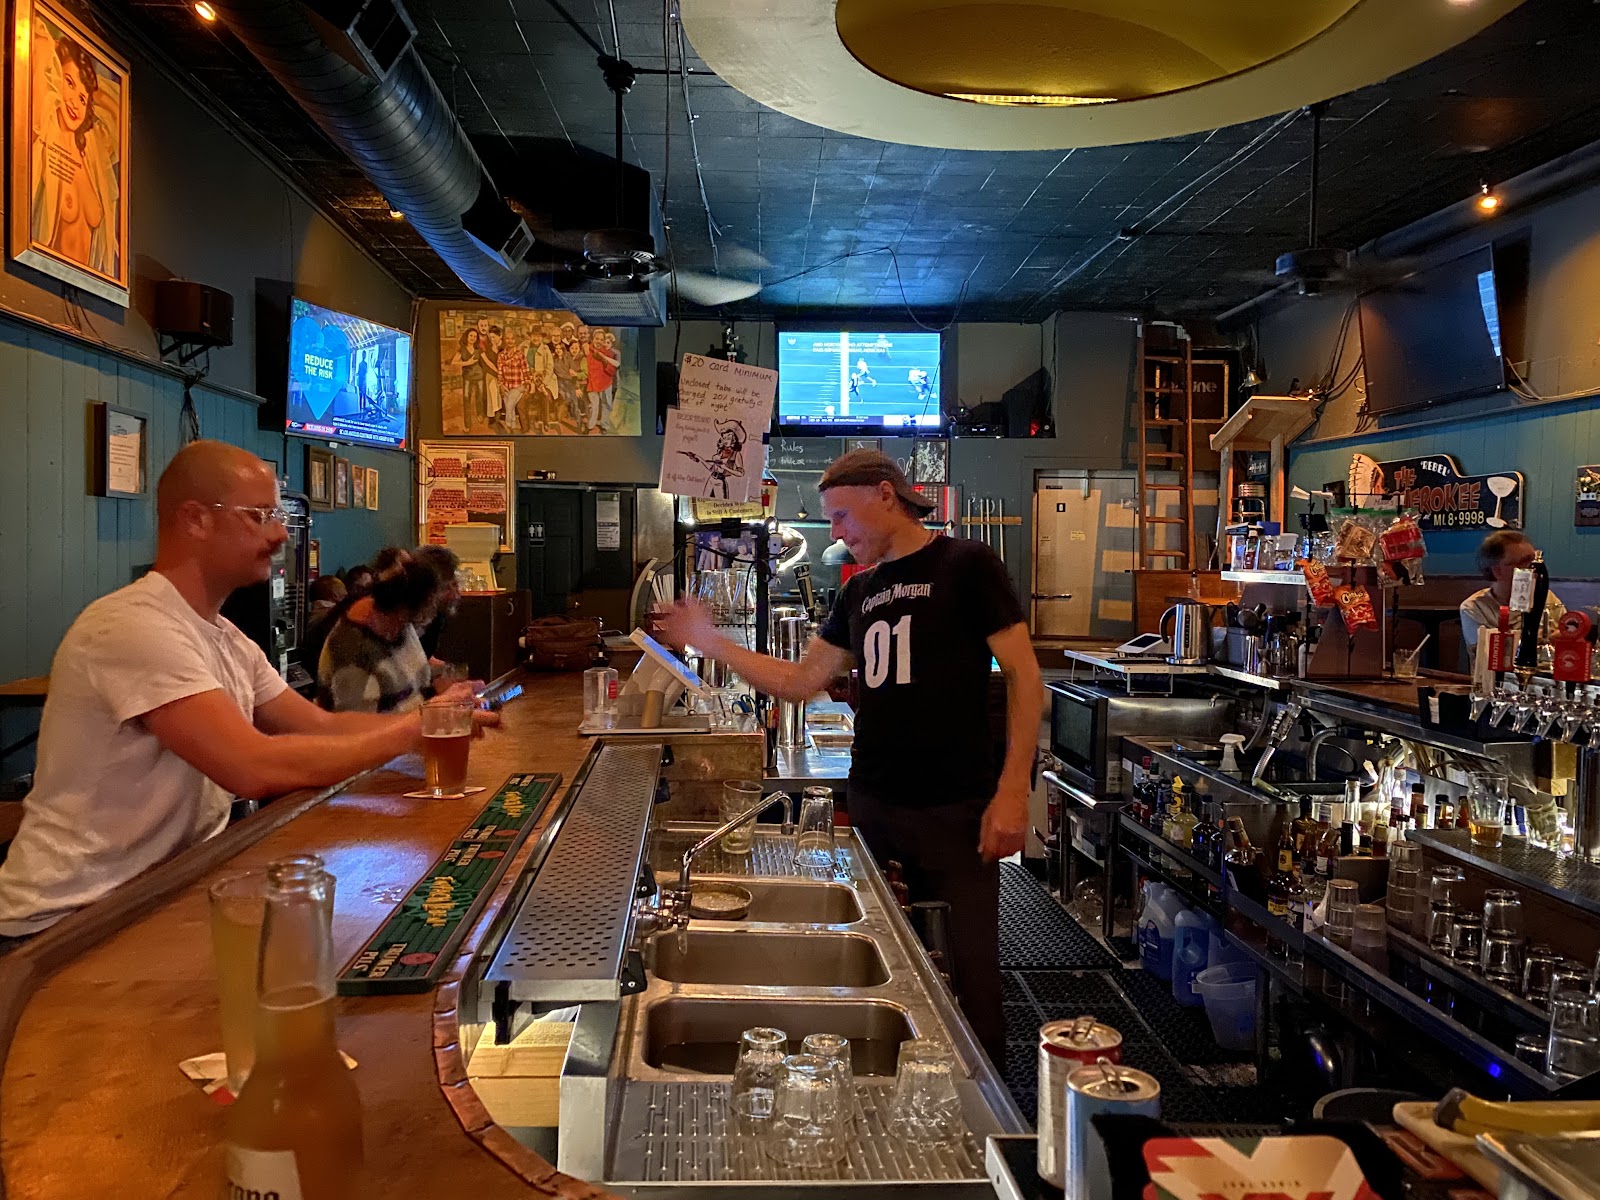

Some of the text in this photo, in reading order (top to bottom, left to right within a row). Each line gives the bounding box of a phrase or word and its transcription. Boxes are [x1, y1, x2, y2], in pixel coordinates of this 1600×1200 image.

[304, 353, 334, 370] REDUCE
[684, 355, 705, 367] $20
[304, 364, 333, 380] THE RISK
[751, 389, 761, 398] be
[780, 438, 804, 454] Rules
[1394, 466, 1417, 490] THE
[862, 583, 931, 614] Captain Morgan
[863, 615, 912, 688] 01
